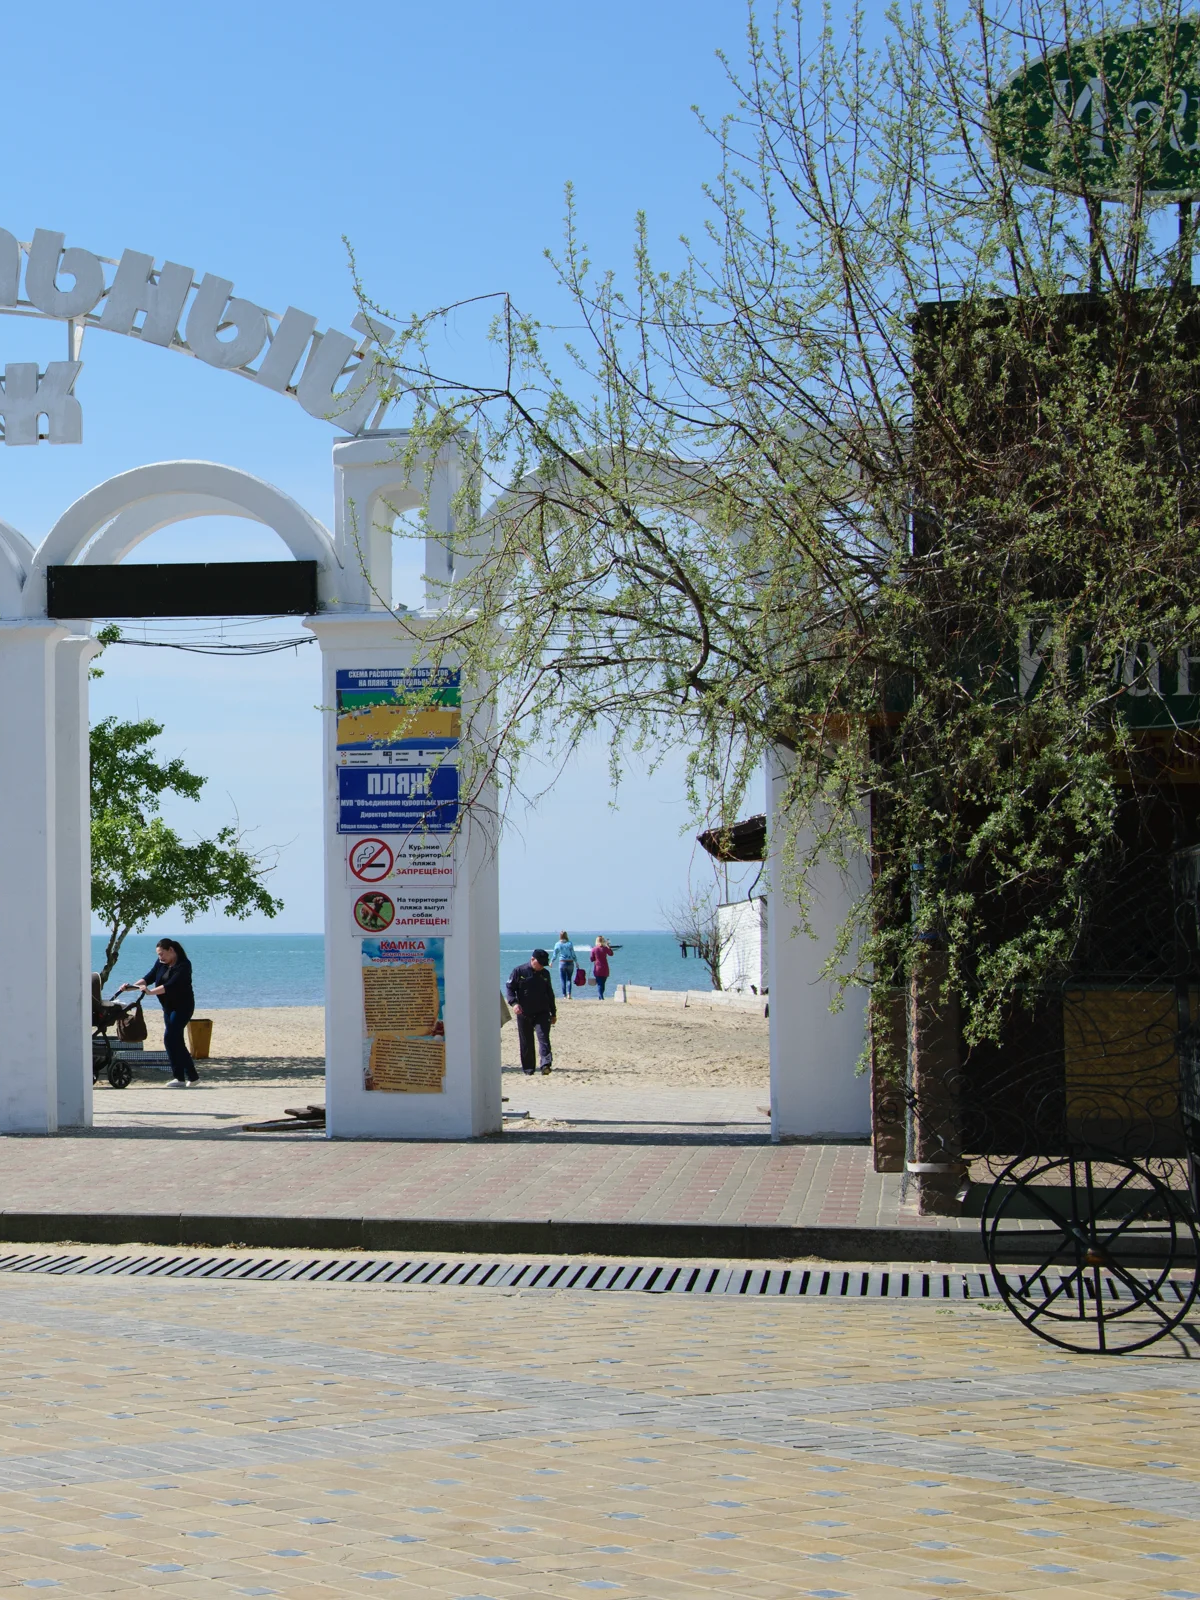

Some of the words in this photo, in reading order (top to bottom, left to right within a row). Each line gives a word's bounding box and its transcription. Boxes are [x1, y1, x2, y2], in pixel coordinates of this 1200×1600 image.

[368, 679, 388, 687] ПЛЯЖЕ
[368, 773, 429, 794] ПЛЯЖ
[380, 941, 426, 950] КАМКА
